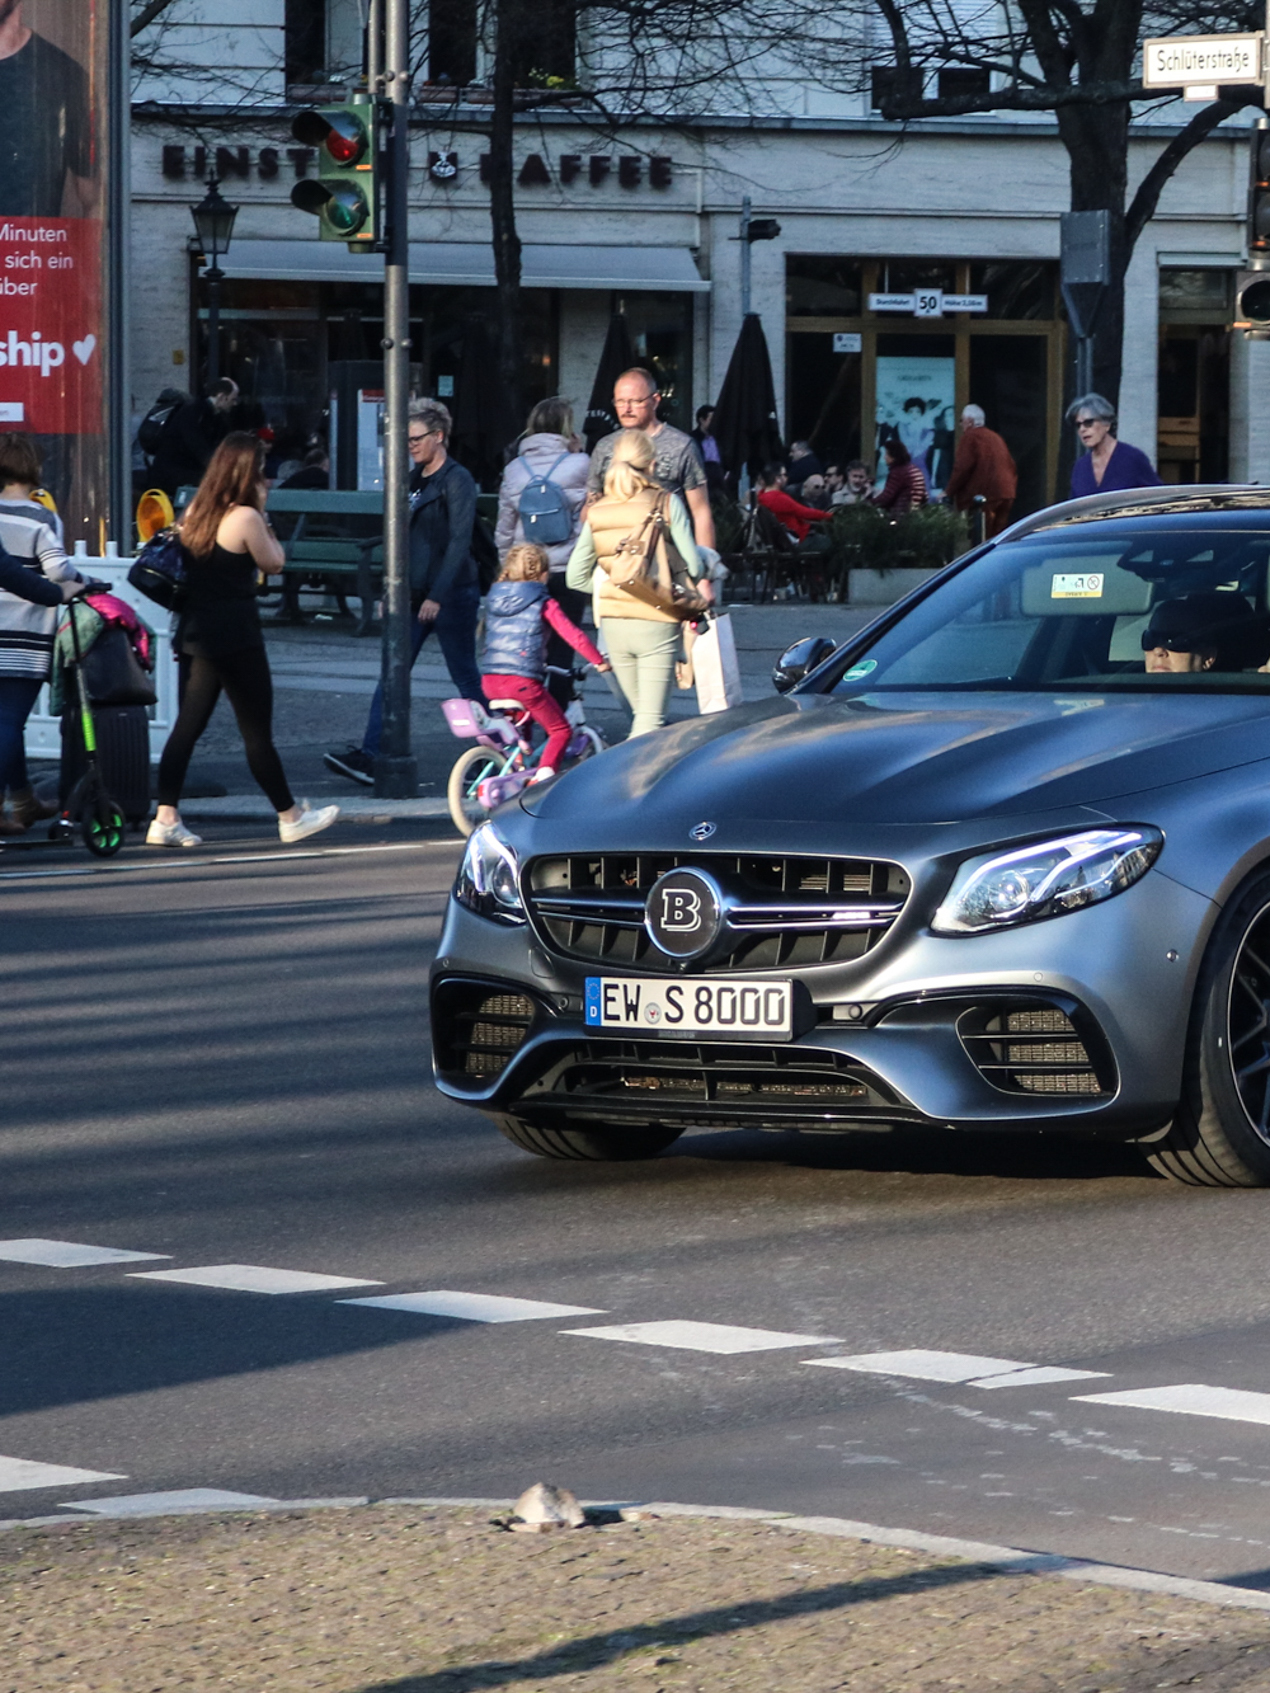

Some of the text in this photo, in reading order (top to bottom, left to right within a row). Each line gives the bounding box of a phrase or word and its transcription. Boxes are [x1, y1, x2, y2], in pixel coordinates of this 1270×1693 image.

[1156, 48, 1250, 73] Schlüterstraße
[4, 250, 74, 269] sich ein
[919, 296, 937, 310] 50
[660, 888, 701, 932] B
[590, 1005, 598, 1018] D
[603, 983, 786, 1026] EW S 8000
